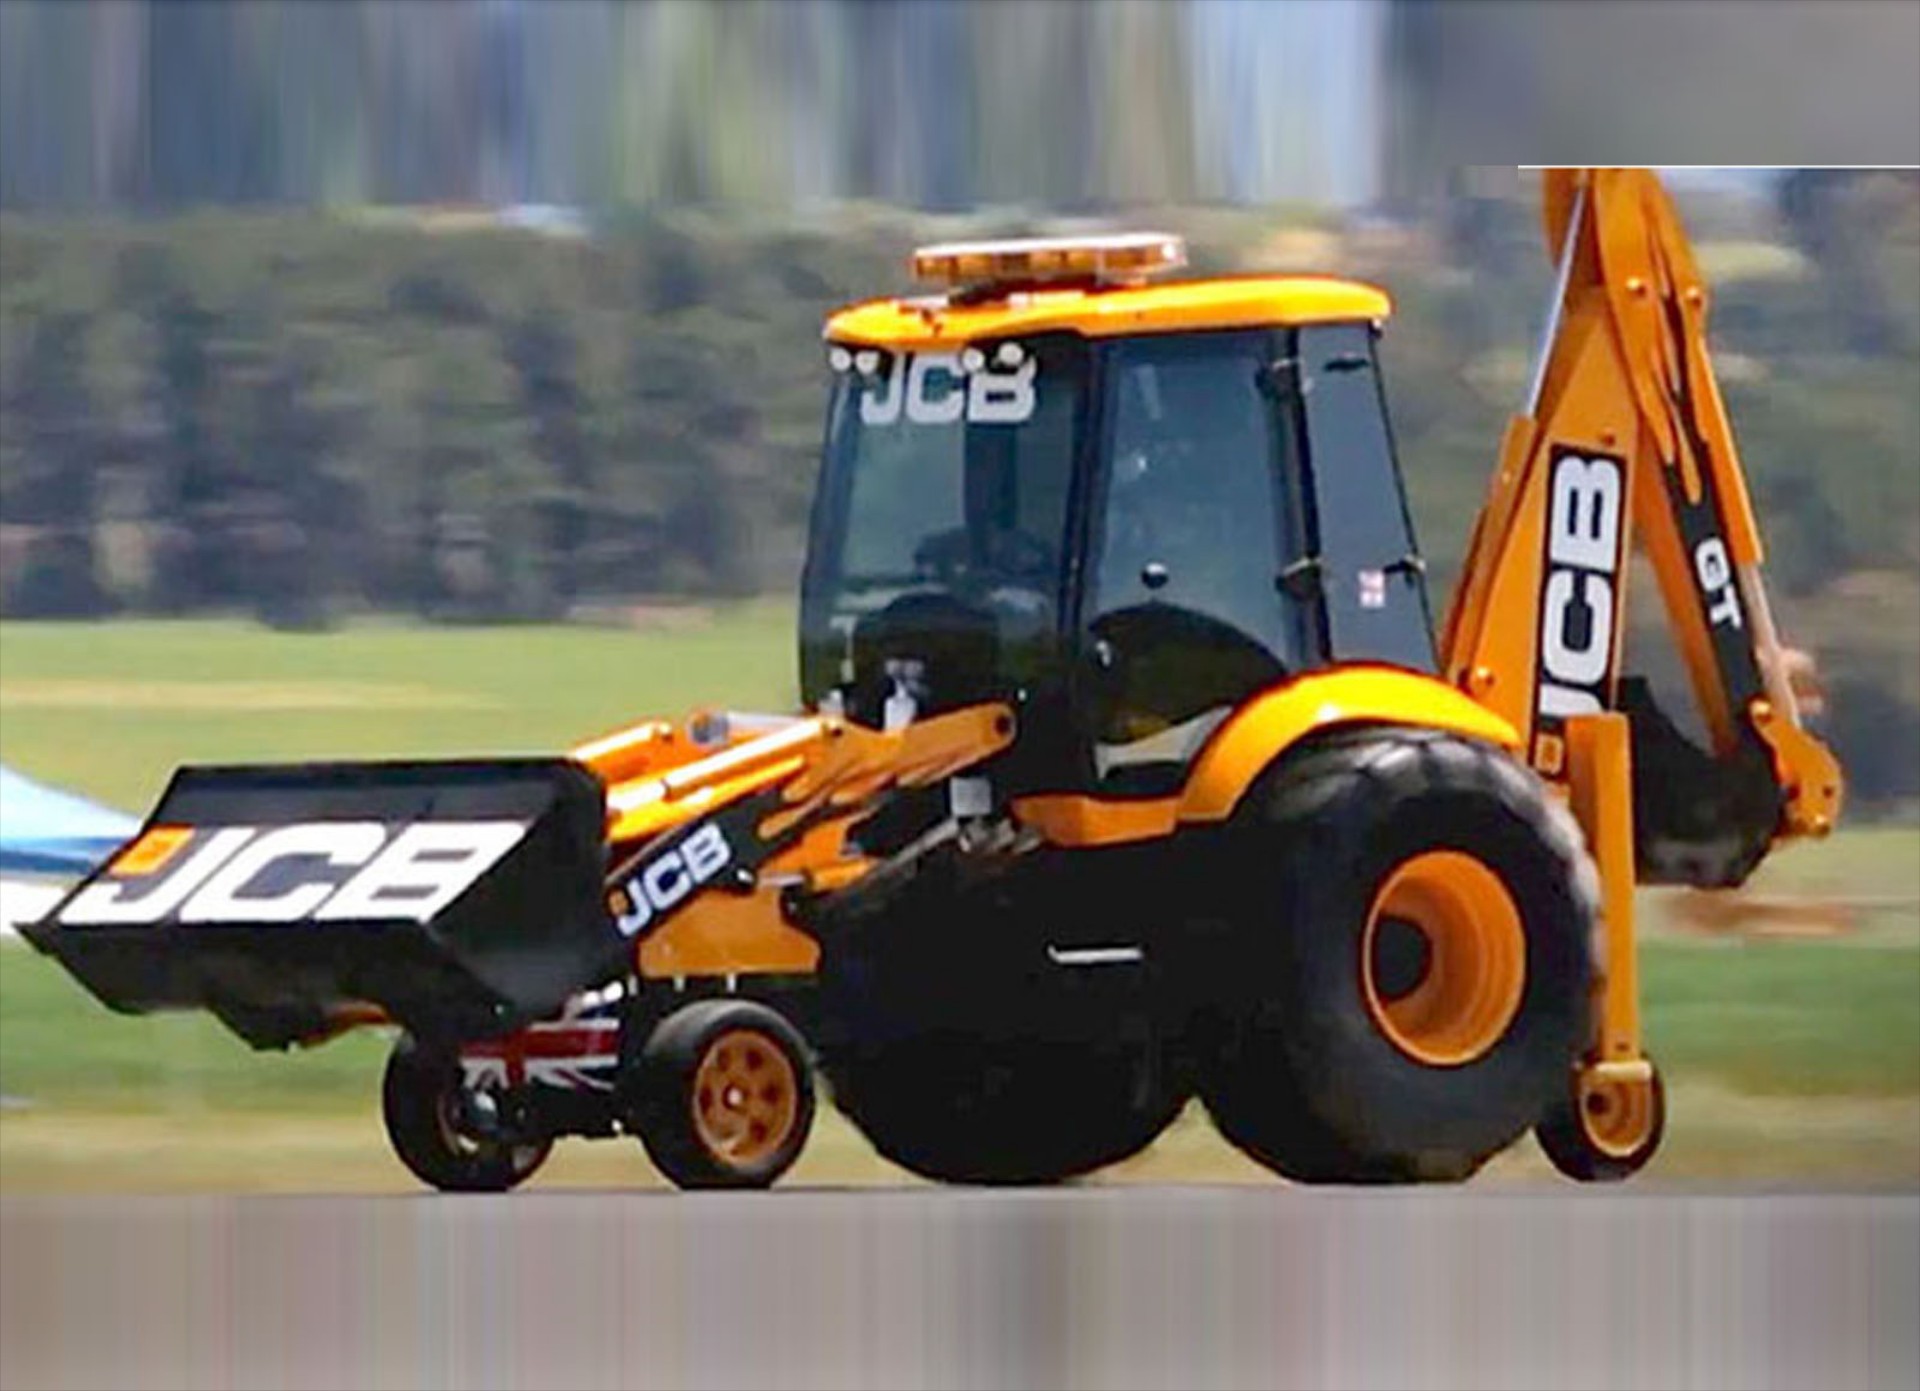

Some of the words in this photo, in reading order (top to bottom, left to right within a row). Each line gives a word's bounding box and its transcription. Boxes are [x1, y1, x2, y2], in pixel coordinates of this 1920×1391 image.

[860, 352, 1037, 424] JCB
[1694, 537, 1742, 629] GT
[58, 822, 528, 925] JCB
[615, 822, 731, 936] JCB
